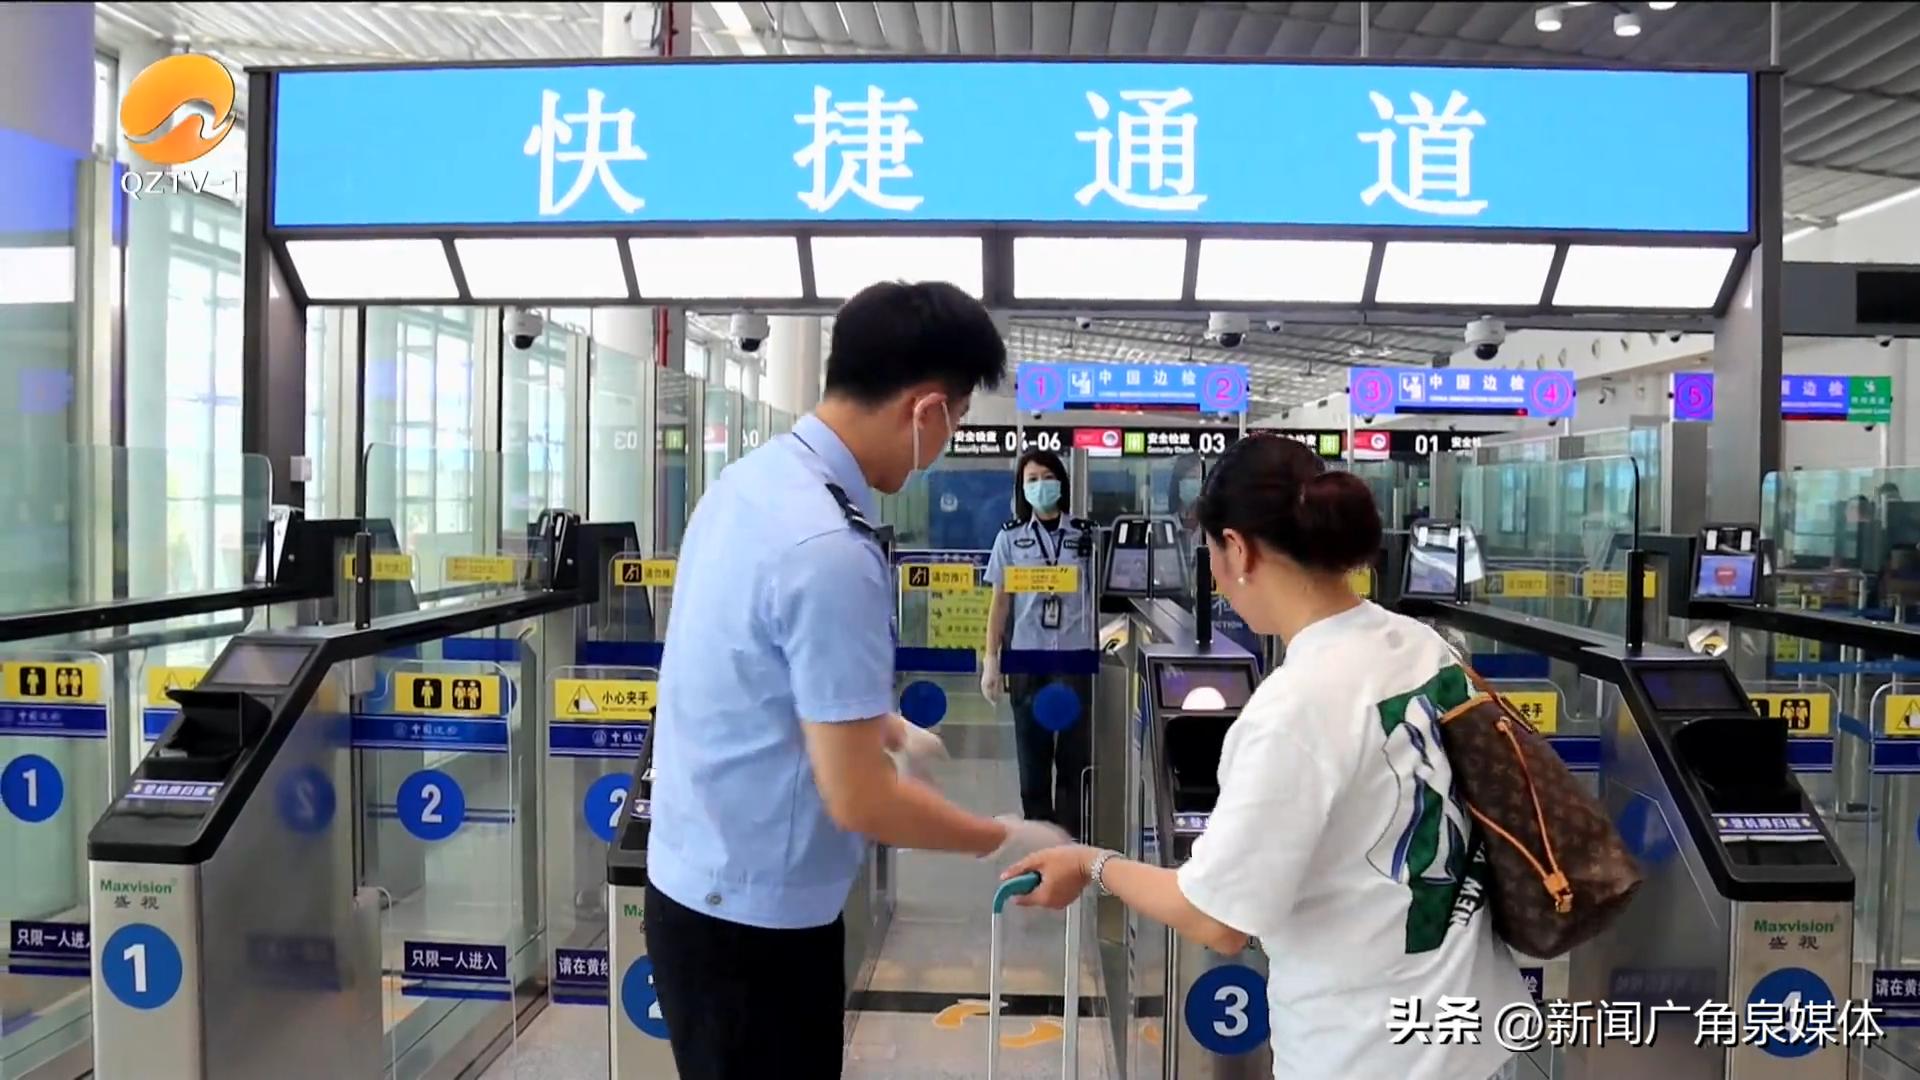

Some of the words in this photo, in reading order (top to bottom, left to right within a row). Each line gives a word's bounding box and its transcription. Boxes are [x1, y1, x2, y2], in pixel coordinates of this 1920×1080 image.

[523, 85, 1489, 216] 快捷通道
[1033, 376, 1046, 398] 1
[1099, 369, 1196, 386] 中国边检
[1429, 373, 1525, 391] 中国边检
[1215, 379, 1231, 400] 2
[1365, 381, 1380, 401] 3
[1543, 383, 1558, 404] 4
[1690, 386, 1703, 408] 5
[1147, 432, 1190, 444] 安全检查
[1199, 433, 1225, 454] 03
[1415, 435, 1438, 454] 01
[602, 690, 649, 706] 小心夹手
[22, 768, 38, 808] 1
[420, 783, 443, 824] 2
[100, 879, 173, 894] Maxvision
[1449, 876, 1483, 927] NEW
[1753, 919, 1834, 933] Maxvision
[122, 943, 148, 993] 1
[411, 949, 499, 971] 只限一人进入
[1876, 977, 1920, 997] 请在黄
[1212, 984, 1250, 1038] 3
